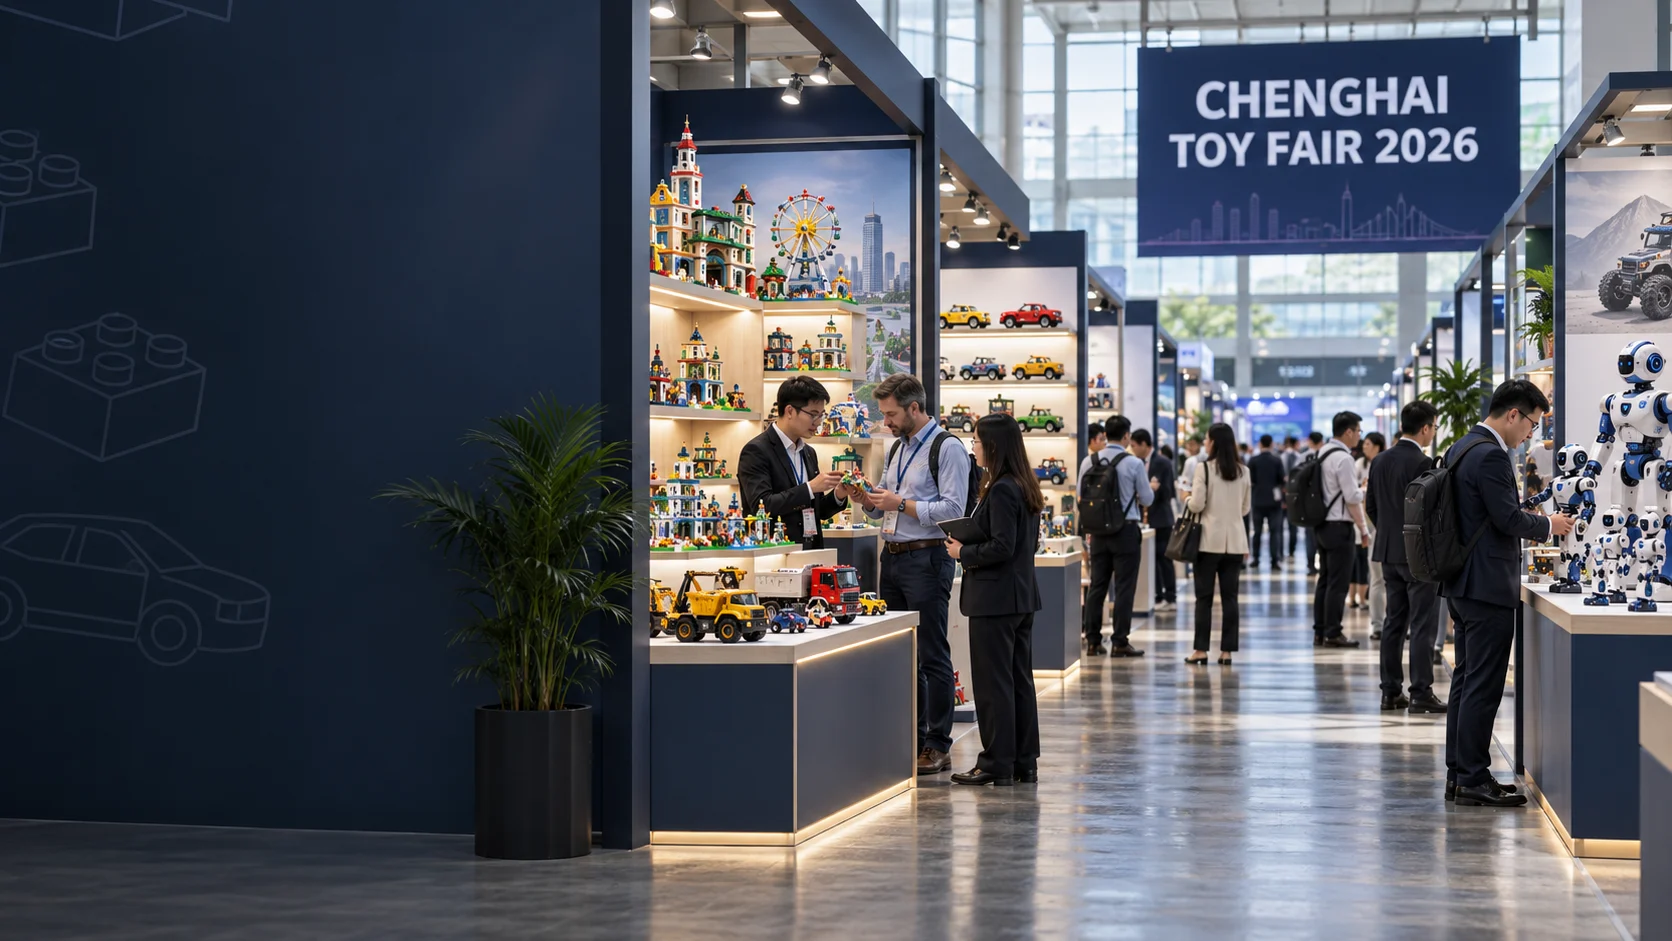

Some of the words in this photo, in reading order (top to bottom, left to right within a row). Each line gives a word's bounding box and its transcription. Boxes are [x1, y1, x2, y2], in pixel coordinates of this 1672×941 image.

[1195, 75, 1448, 119] CHENGHAI
[1168, 131, 1255, 168] TOY
[1267, 130, 1364, 166] FAIR
[1375, 126, 1479, 164] 2026
